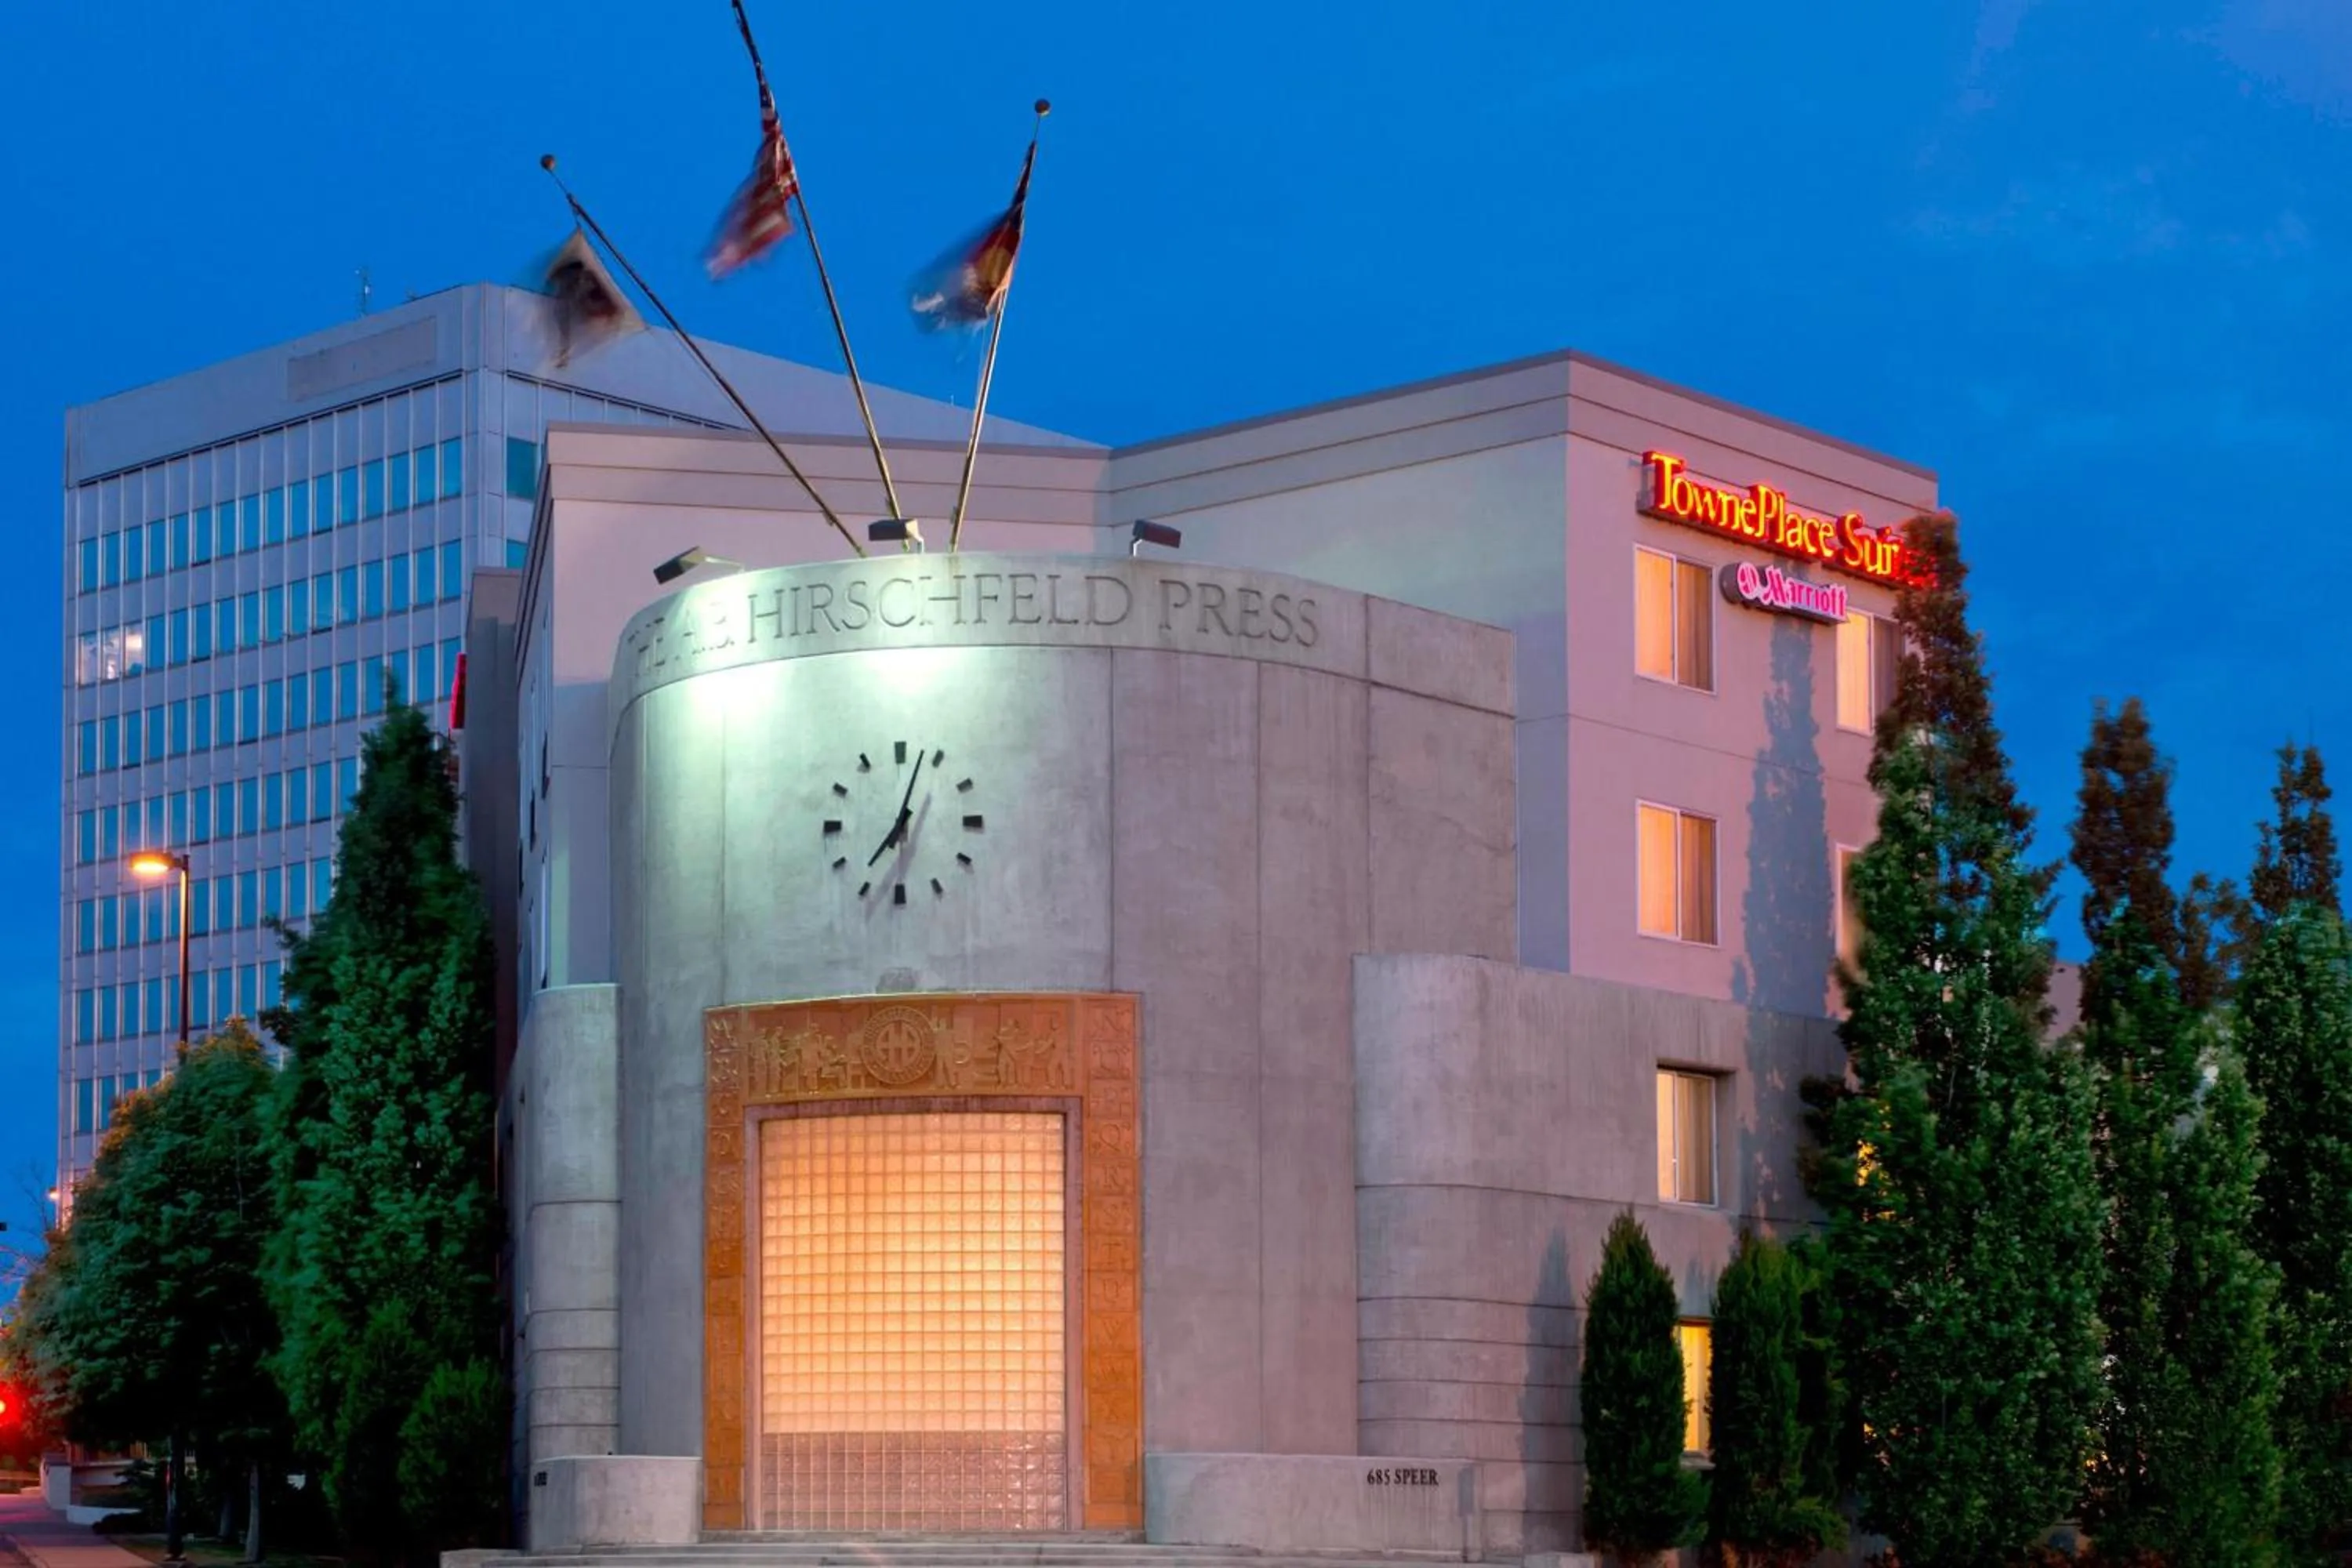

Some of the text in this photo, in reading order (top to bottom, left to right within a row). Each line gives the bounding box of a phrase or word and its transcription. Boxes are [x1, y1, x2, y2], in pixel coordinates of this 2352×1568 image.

[1648, 451, 1913, 579] TownePlace Sui
[747, 573, 1133, 644] HIRSCHFELD
[1158, 579, 1319, 648] PRESS
[1760, 564, 1848, 620] Marriott
[1367, 1468, 1439, 1486] 685 SPEER
